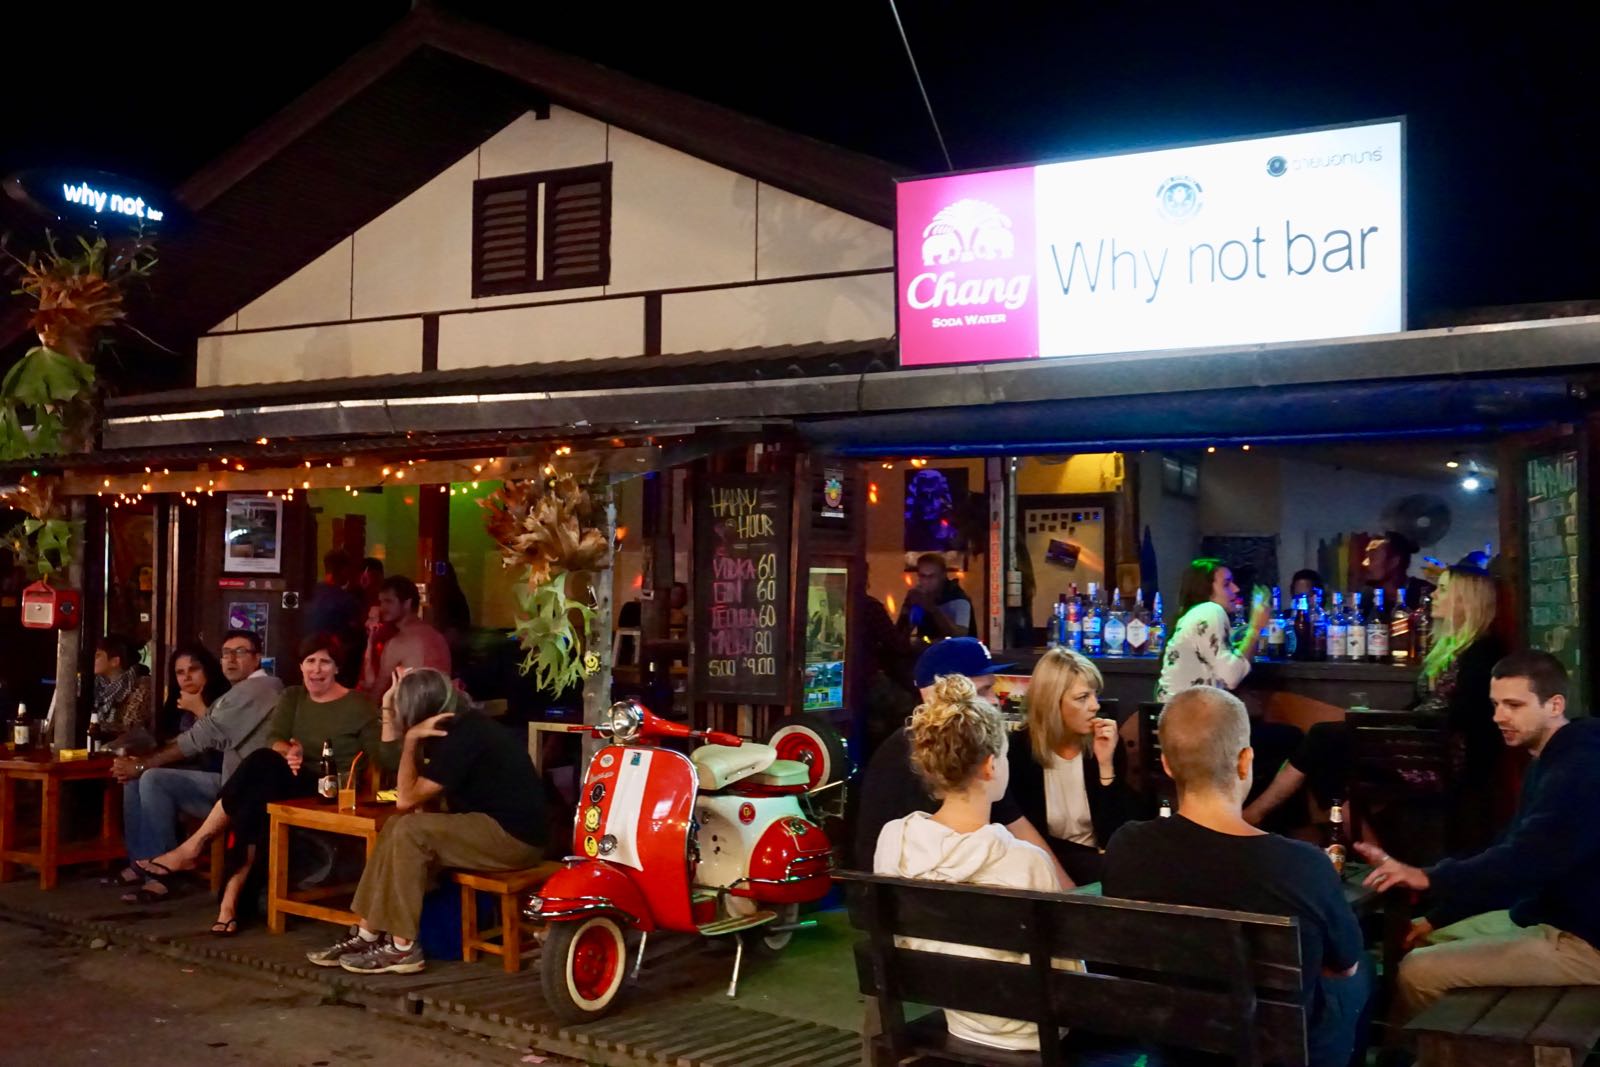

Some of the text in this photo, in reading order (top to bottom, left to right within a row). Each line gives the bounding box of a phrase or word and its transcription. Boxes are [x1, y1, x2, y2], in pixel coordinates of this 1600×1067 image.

[63, 182, 107, 213] why
[110, 194, 145, 218] not
[1052, 217, 1379, 304] Why not bar
[907, 271, 1031, 311] Chang
[931, 312, 1007, 329] SODA WATER
[709, 487, 758, 517] HAPPY
[737, 514, 775, 539] HOUR
[758, 553, 776, 580] 60
[757, 580, 776, 602] 60
[759, 604, 776, 628] 60
[755, 631, 773, 655] 80
